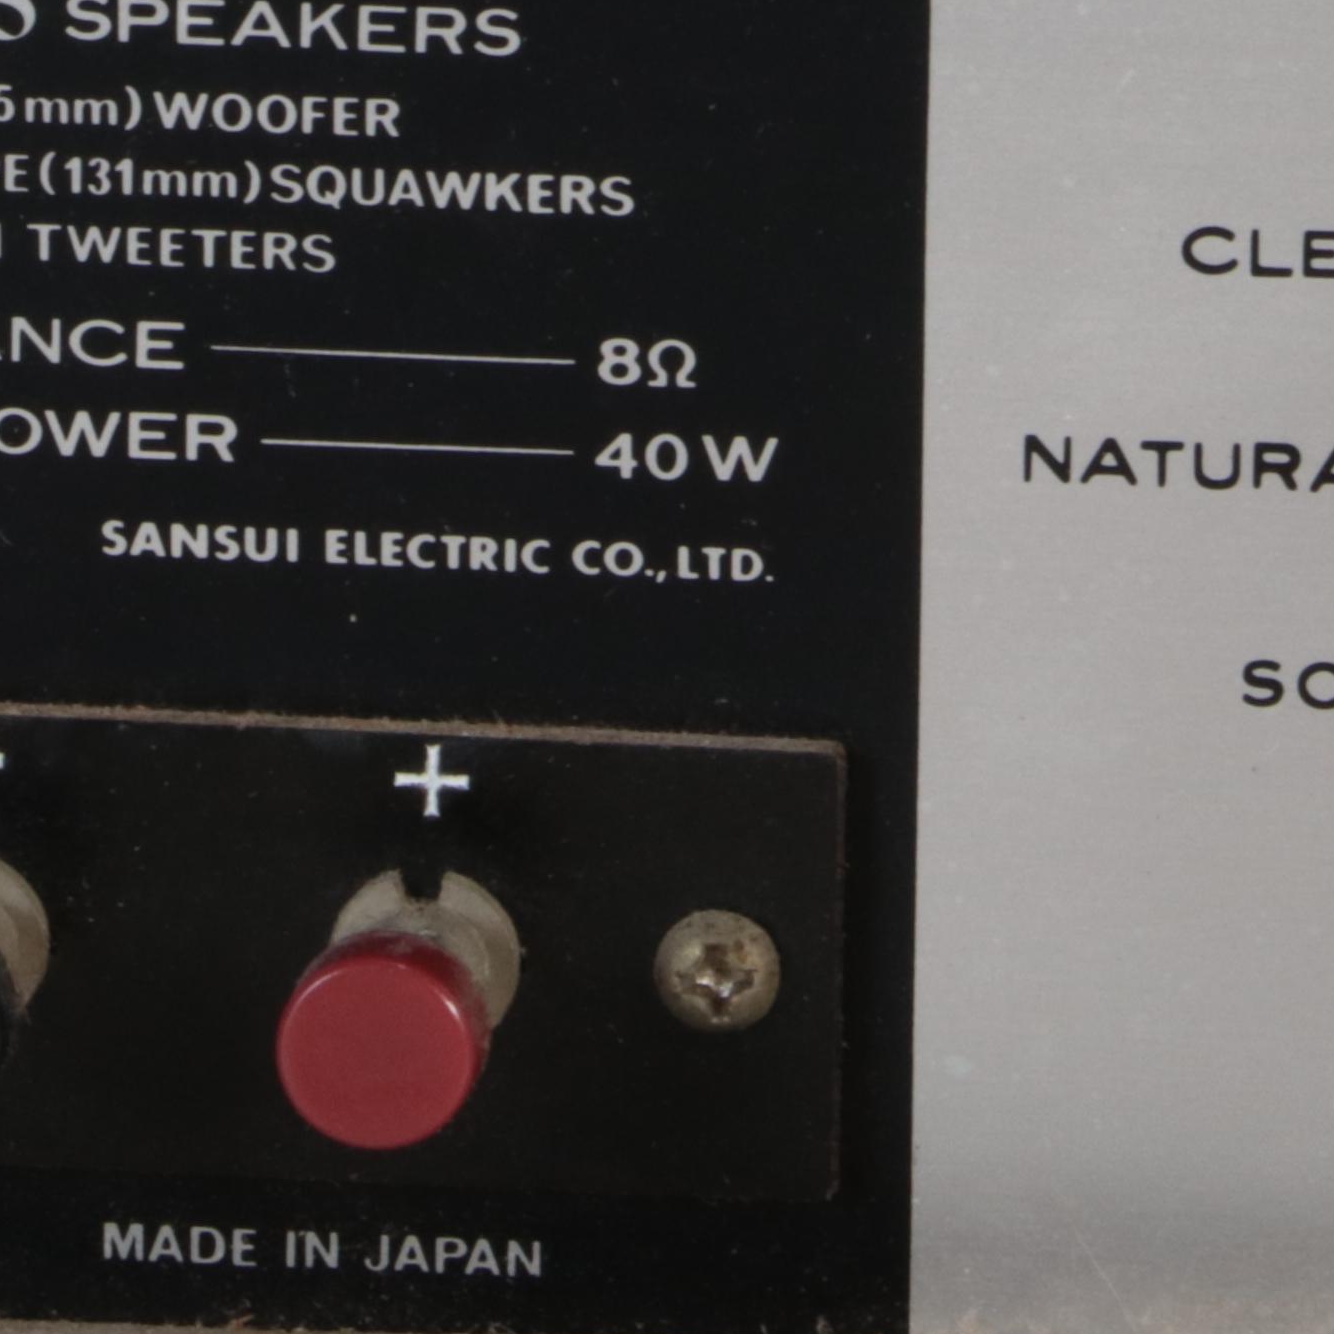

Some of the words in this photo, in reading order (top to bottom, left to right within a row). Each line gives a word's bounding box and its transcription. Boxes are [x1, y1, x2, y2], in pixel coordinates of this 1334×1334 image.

[26, 223, 336, 274] TWEETERS
[100, 519, 300, 563] SANSUI
[324, 528, 551, 575] ELECTRIC
[102, 1221, 257, 1267] MADE
[285, 1230, 340, 1269] IN
[364, 1234, 541, 1277] JAPAN
